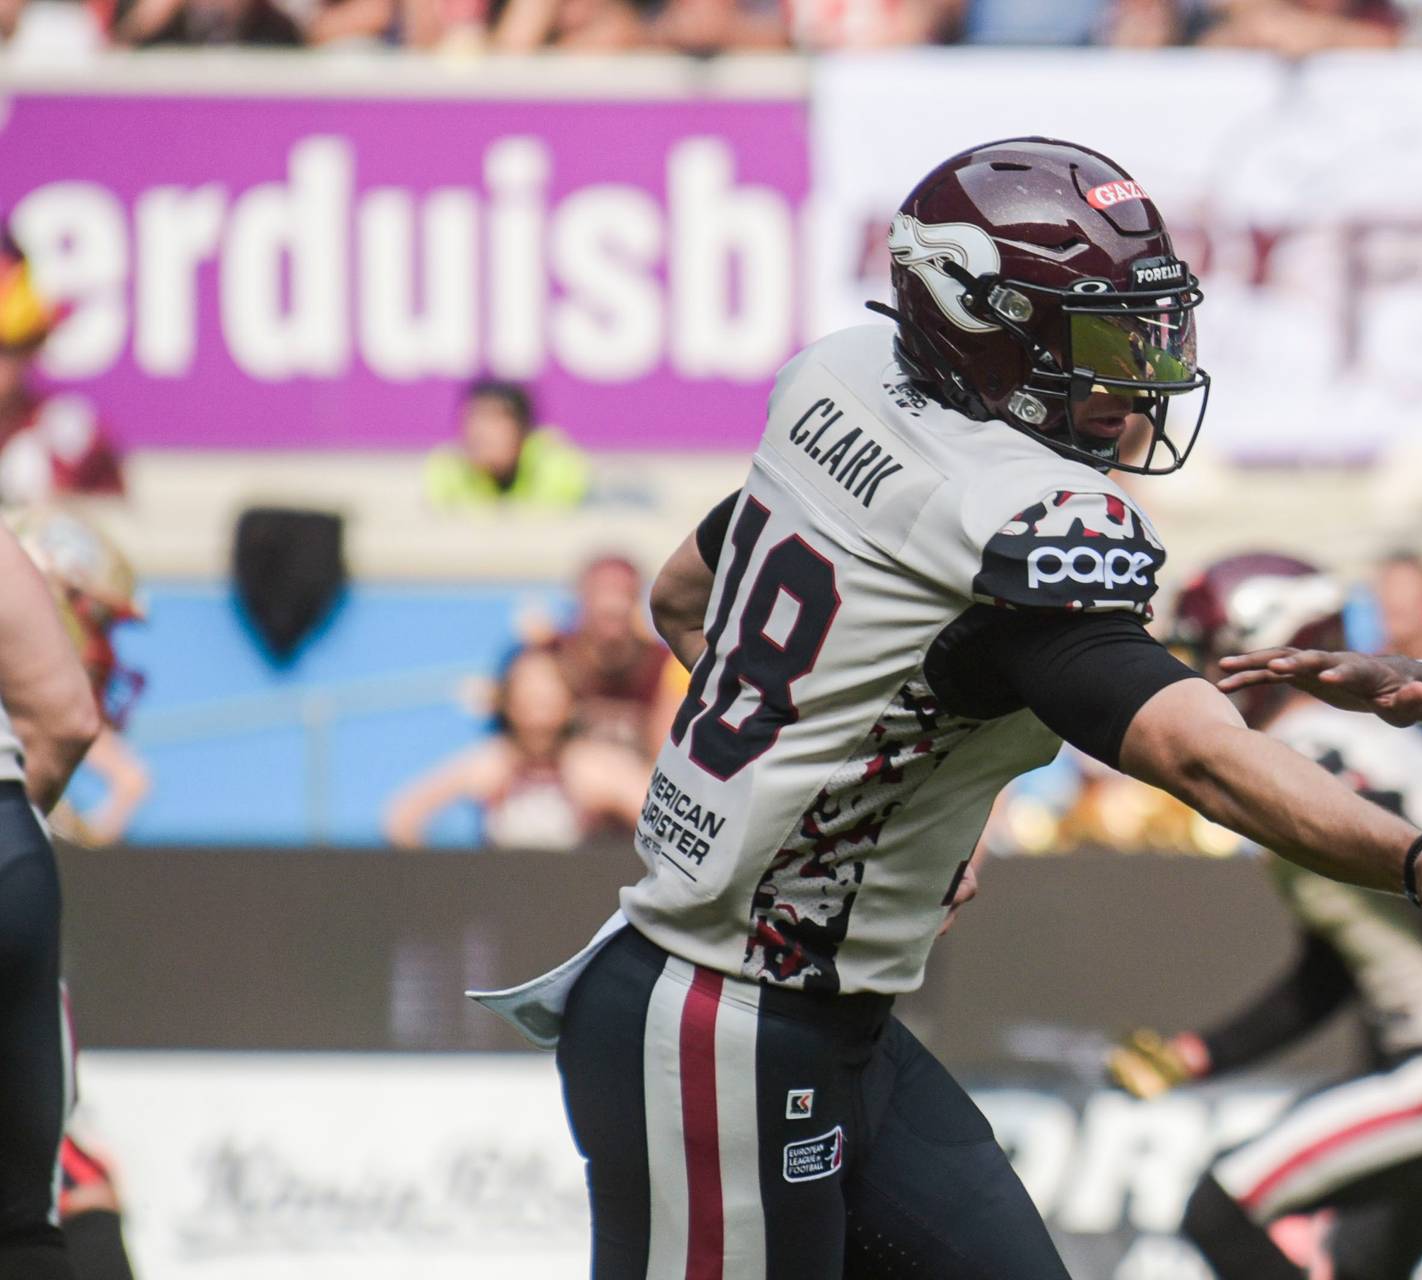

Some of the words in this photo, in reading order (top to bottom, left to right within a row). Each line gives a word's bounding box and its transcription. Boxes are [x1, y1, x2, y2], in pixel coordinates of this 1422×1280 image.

[9, 134, 806, 384] erduisb
[789, 397, 904, 509] CLARK
[1027, 546, 1154, 590] pape
[671, 493, 842, 782] 18
[651, 765, 727, 839] MERICAN
